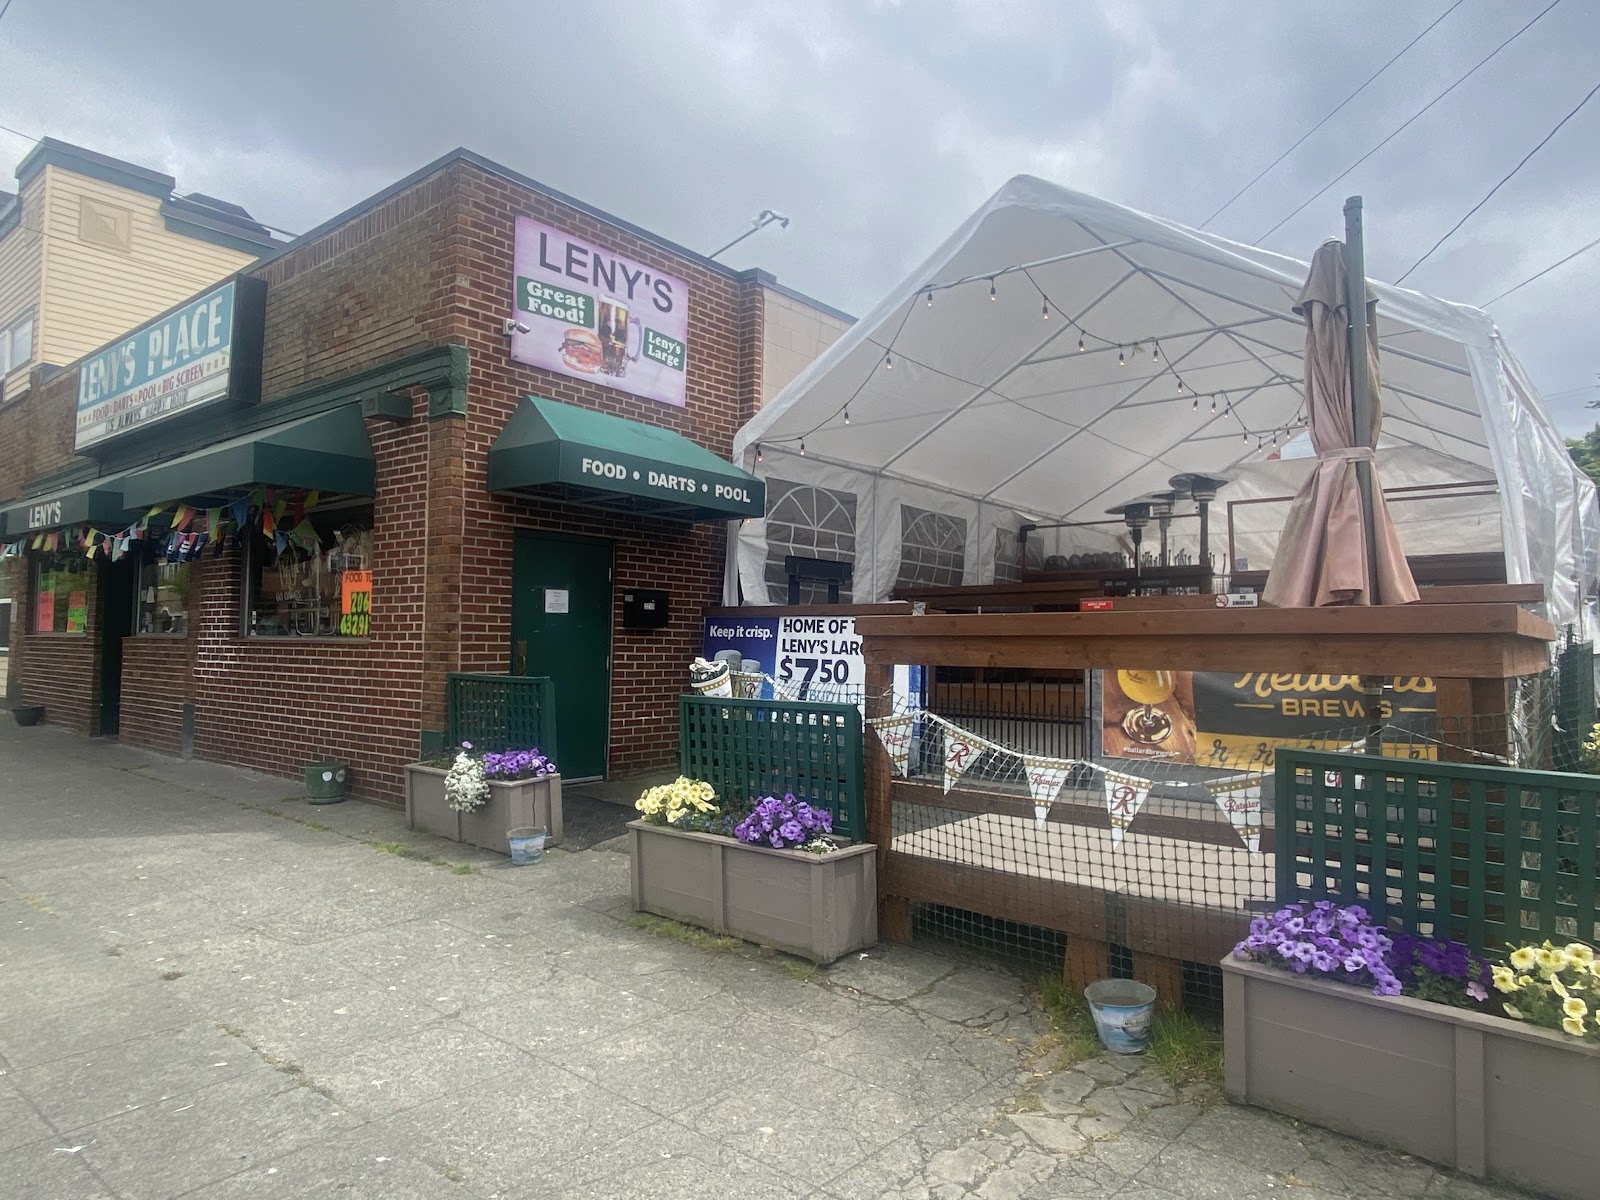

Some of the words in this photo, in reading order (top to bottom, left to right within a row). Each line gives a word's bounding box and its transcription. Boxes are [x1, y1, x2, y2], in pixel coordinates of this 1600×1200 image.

[539, 232, 673, 313] LENY'S
[527, 281, 586, 309] Great
[528, 296, 585, 325] Food!
[79, 341, 136, 405] LENY'S
[147, 296, 223, 377] PLACE
[648, 331, 681, 355] Leny's
[647, 345, 679, 367] Large
[92, 403, 110, 422] FOOD
[113, 393, 134, 413] DARTS
[138, 383, 157, 403] POOL
[162, 376, 174, 394] BIG
[176, 362, 204, 388] SCREEN
[582, 458, 627, 480] FOOD
[648, 471, 697, 493] DARTS
[715, 484, 751, 503] POOL
[28, 501, 62, 529] LENY'S
[345, 572, 363, 583] FOOD
[351, 592, 369, 613] 206
[709, 625, 735, 641] Keep
[736, 626, 744, 639] it
[745, 626, 773, 641] crisp.
[783, 619, 826, 634] HOME
[828, 620, 849, 634] OF
[782, 638, 828, 655] LENY'S
[831, 640, 861, 656] LAR
[946, 741, 970, 768] R
[1030, 773, 1062, 786] Rainier
[1111, 785, 1137, 815] R
[1224, 799, 1261, 813] Rainier
